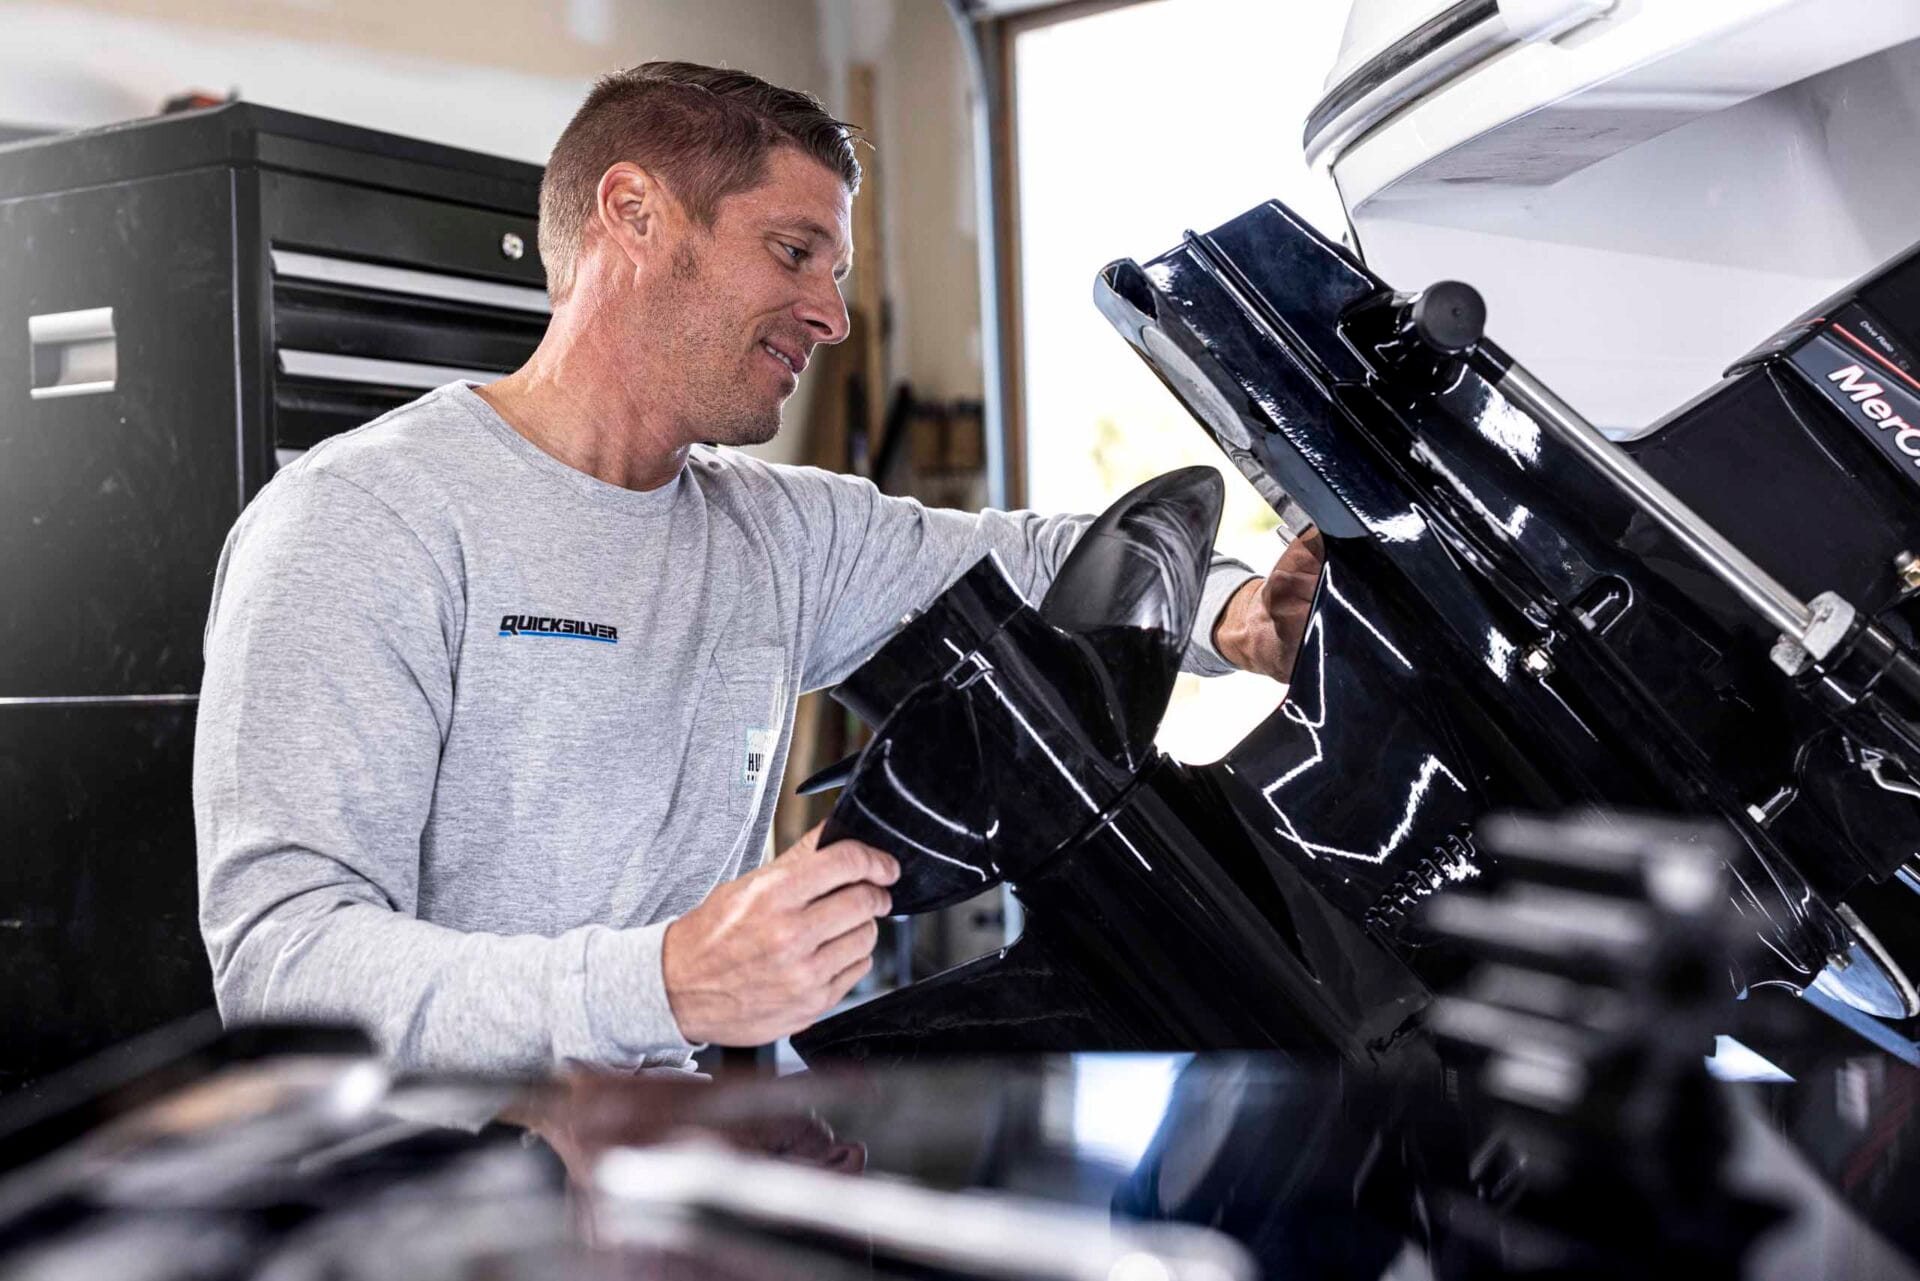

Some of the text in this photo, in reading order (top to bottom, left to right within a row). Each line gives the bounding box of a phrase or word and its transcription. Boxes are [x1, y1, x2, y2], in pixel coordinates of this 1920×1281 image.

[1859, 320, 1878, 337] Drive
[1827, 364, 1920, 467] MerC
[499, 615, 618, 639] QUICKSILVER
[748, 752, 764, 772] HU
